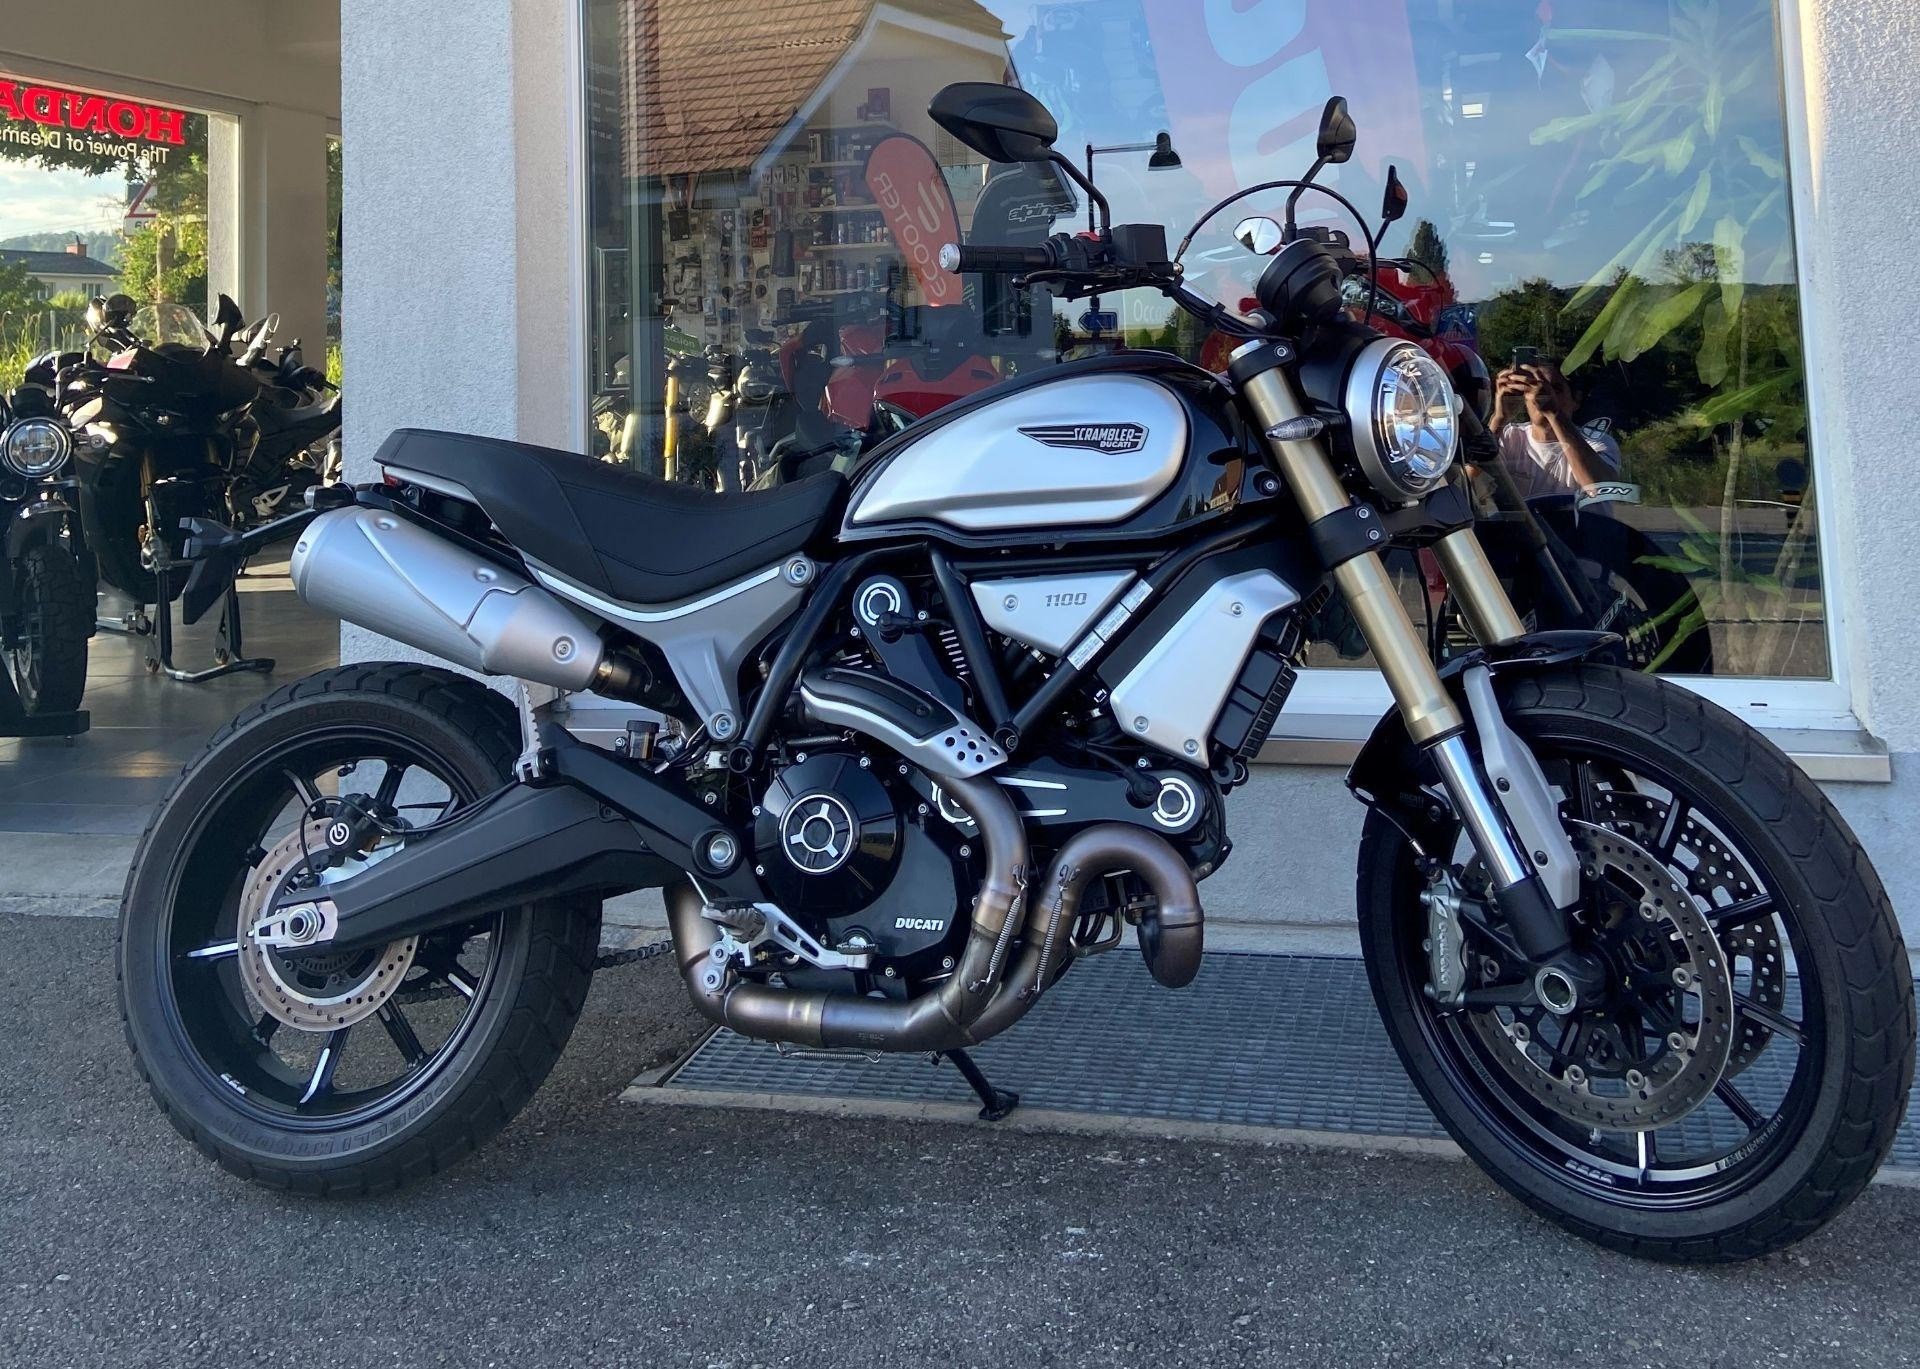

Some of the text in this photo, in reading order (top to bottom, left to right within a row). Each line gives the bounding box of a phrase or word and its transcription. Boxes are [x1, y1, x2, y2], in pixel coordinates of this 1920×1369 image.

[1074, 427, 1136, 442] SCRAMBLER
[1045, 592, 1088, 608] 1100
[895, 917, 943, 931] DUCATI
